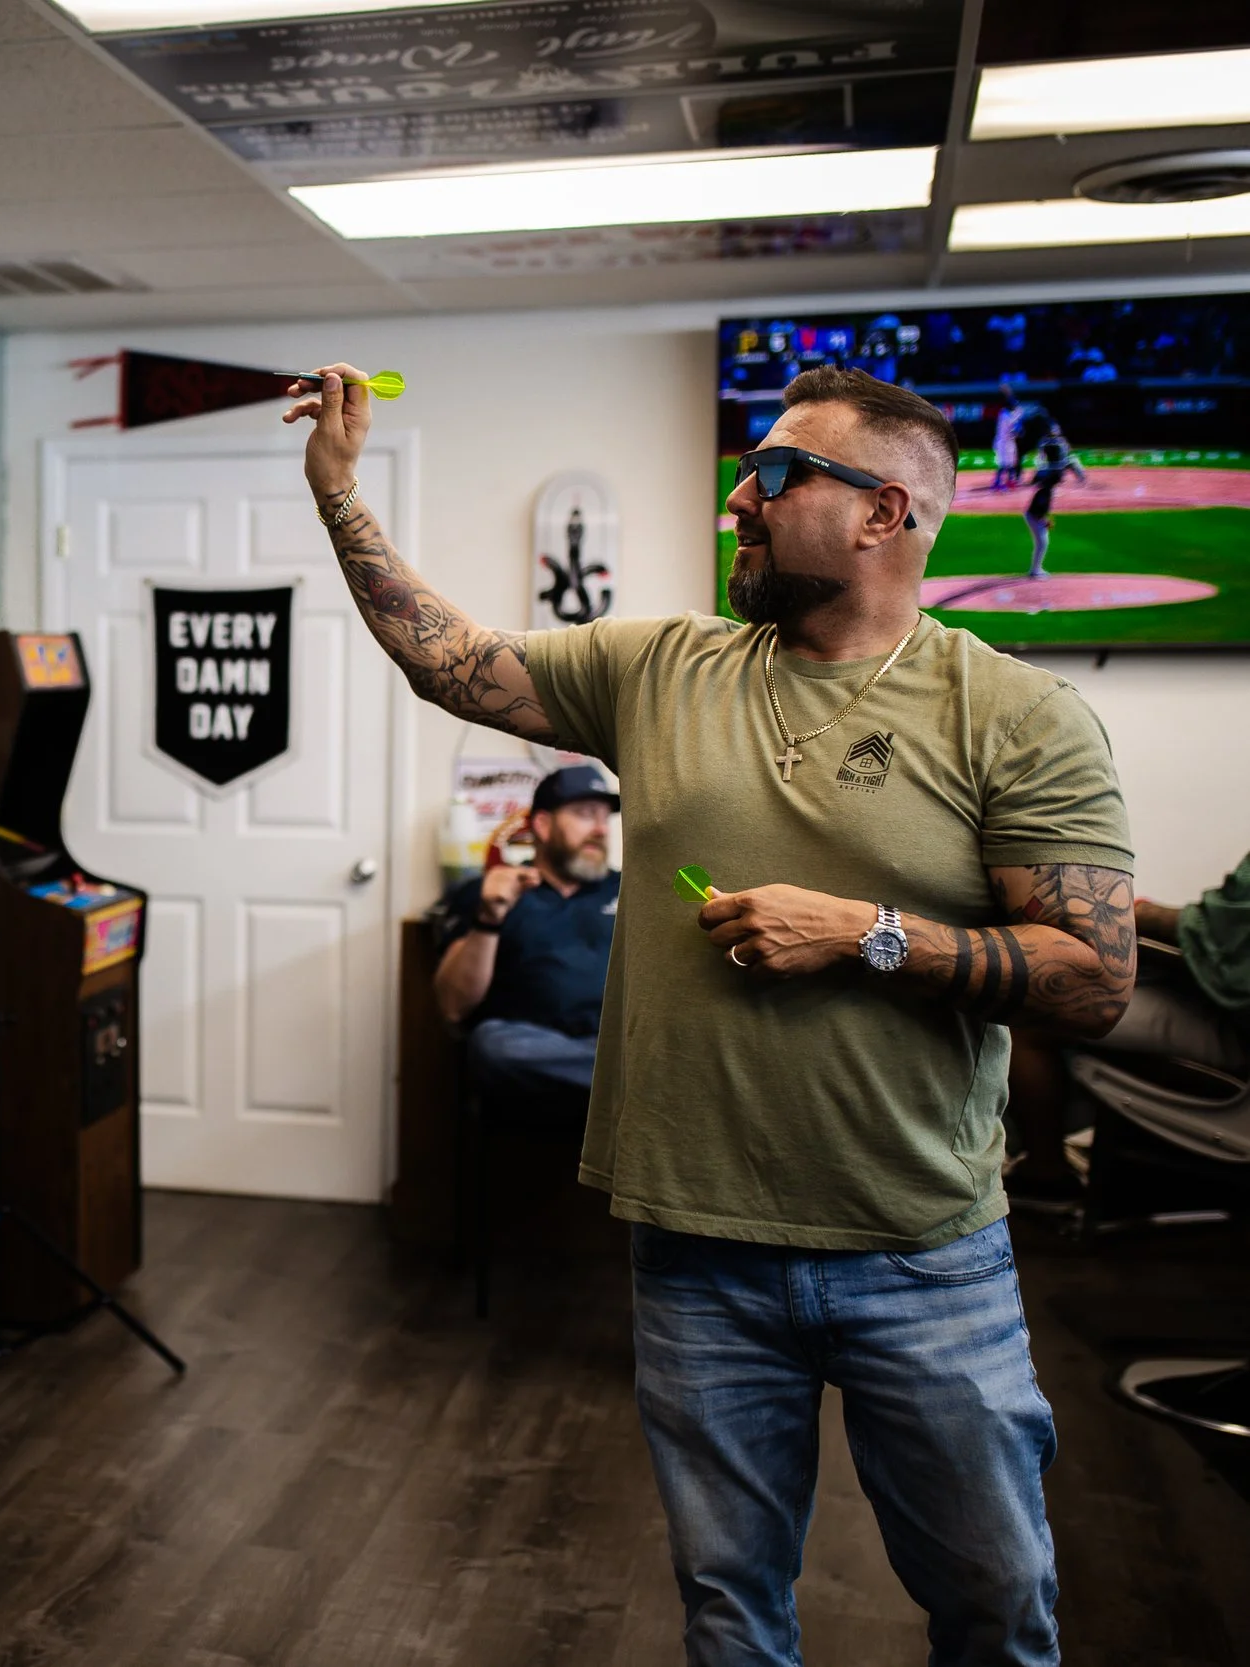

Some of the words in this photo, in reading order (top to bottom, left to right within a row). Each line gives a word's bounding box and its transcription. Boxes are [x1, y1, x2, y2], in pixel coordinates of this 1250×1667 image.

[808, 456, 830, 468] NEVEN
[169, 611, 277, 649] EVERY
[176, 657, 270, 695] DAMN
[190, 703, 254, 741] DAY
[836, 767, 855, 782] HIGH
[855, 775, 862, 784] &
[862, 774, 888, 787] TIGHT
